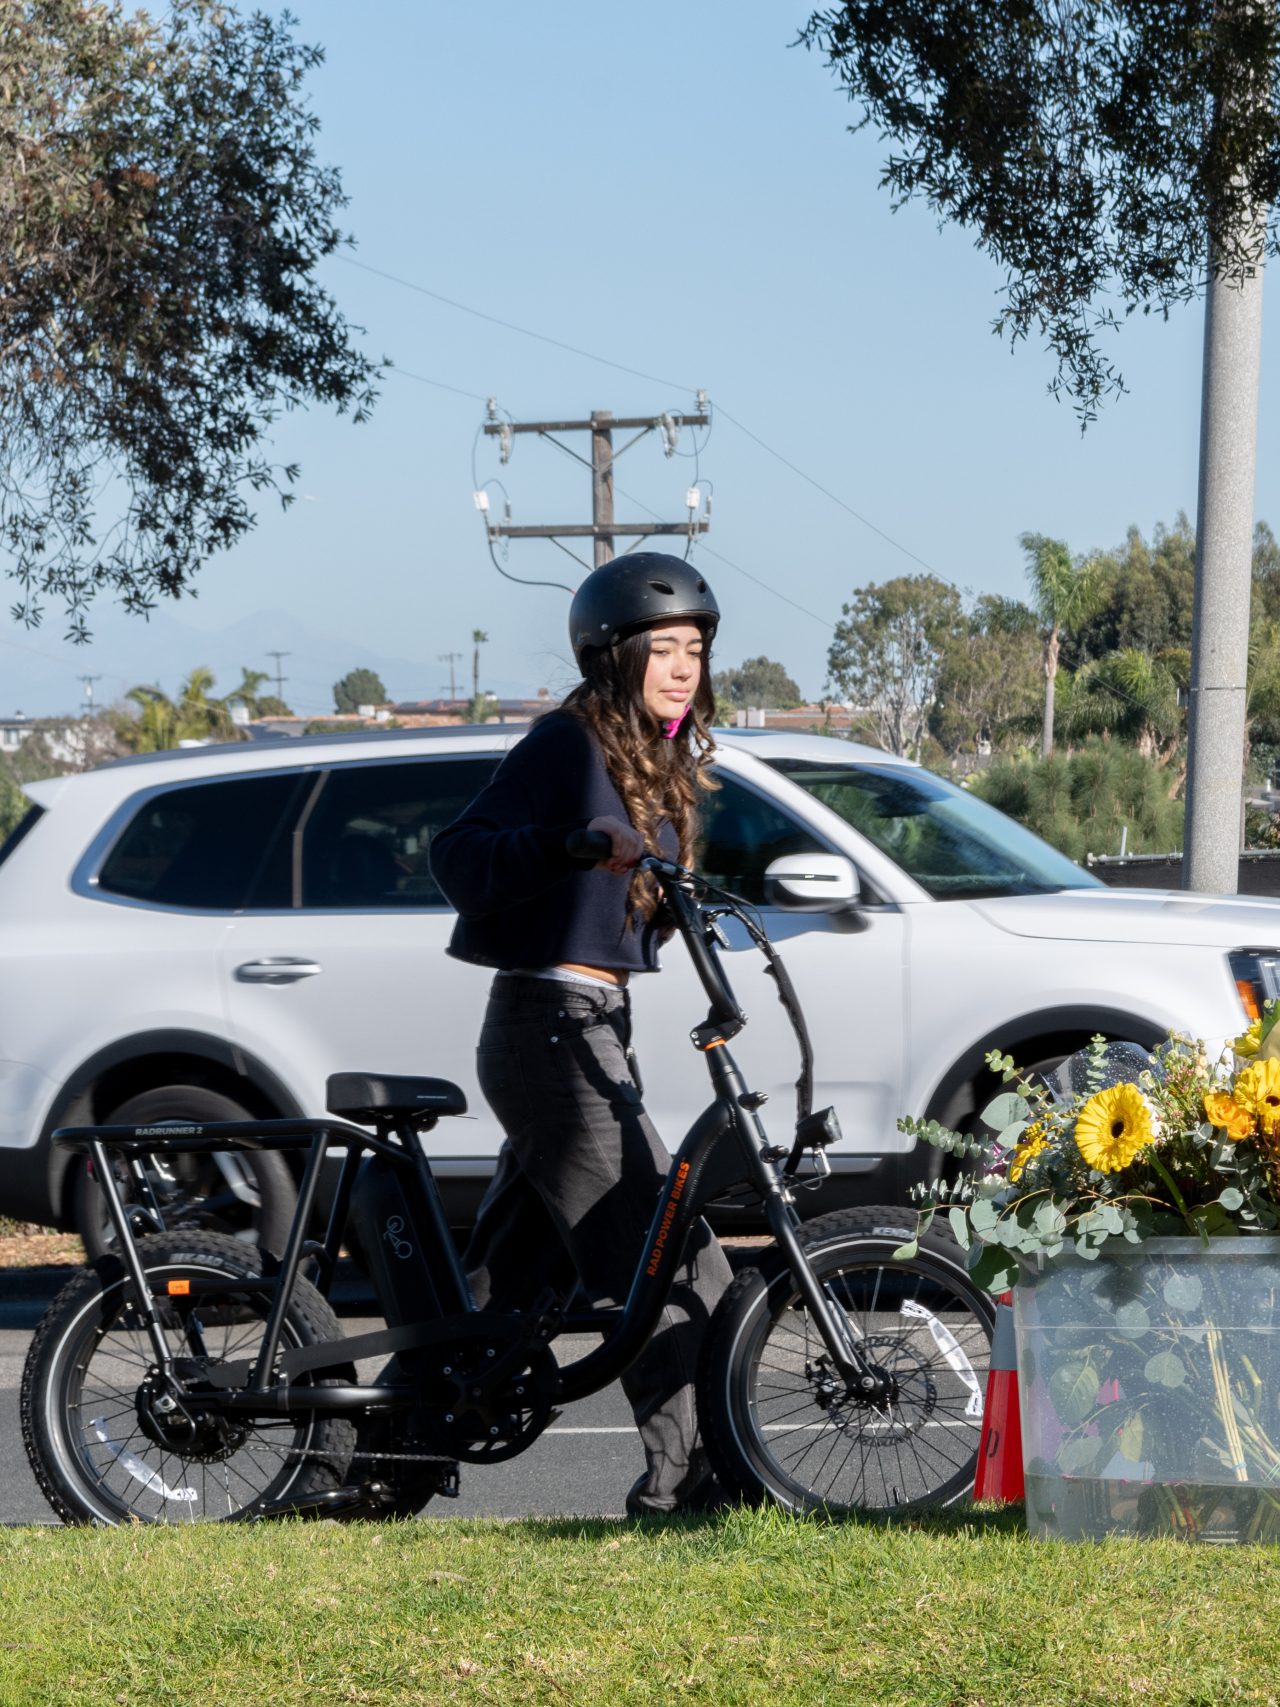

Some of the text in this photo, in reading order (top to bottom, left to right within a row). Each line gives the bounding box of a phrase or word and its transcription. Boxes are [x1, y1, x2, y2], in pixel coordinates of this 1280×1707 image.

[135, 1126, 203, 1136] RADRUNNER 2
[647, 1161, 690, 1276] RAD POWER BIKES
